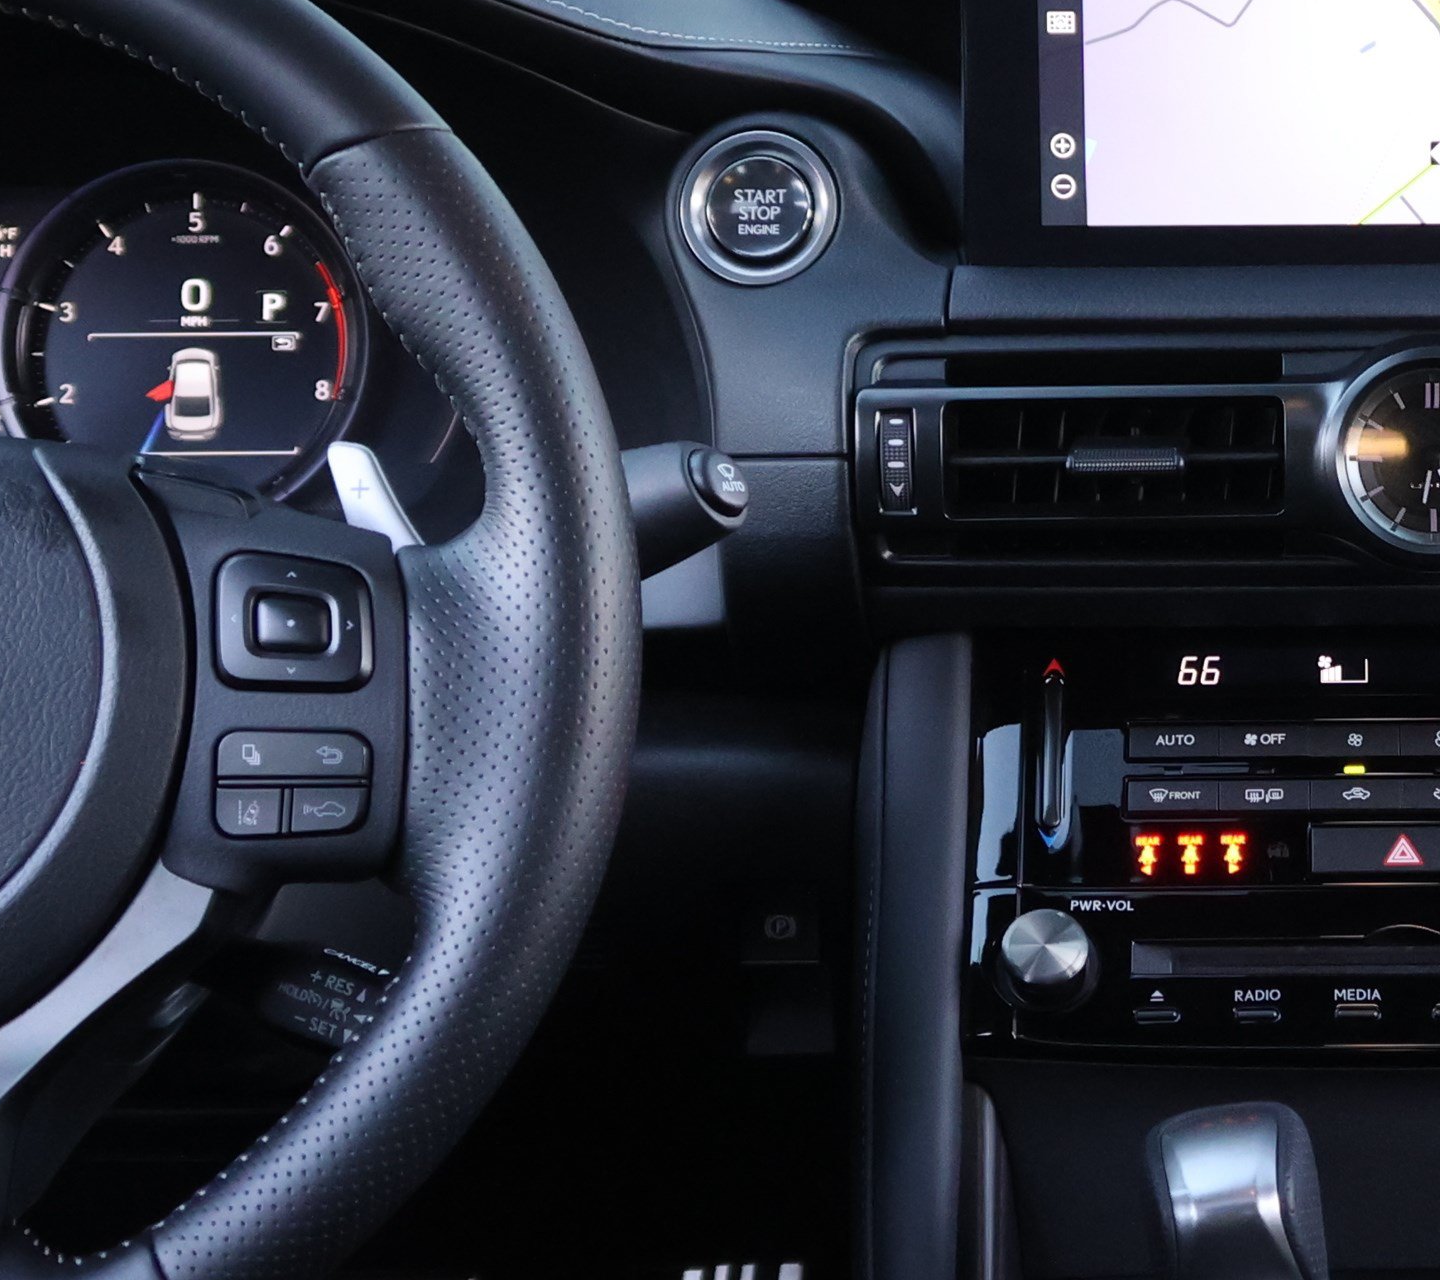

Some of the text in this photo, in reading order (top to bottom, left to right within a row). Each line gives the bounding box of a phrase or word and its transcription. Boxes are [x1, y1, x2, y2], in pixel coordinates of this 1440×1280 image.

[734, 189, 787, 204] START
[738, 206, 782, 220] STOP
[188, 212, 205, 233] 5
[738, 224, 780, 235] ENGINE
[0, 243, 14, 258] H
[107, 236, 125, 256] 4
[263, 235, 281, 256] 6
[180, 278, 209, 312] 0
[59, 302, 75, 322] 3
[262, 292, 284, 321] P
[313, 301, 331, 322] 7
[180, 316, 209, 327] MPH
[59, 383, 75, 404] 2
[314, 379, 331, 401] 8
[721, 480, 746, 492] AUTO
[1177, 656, 1220, 685] 66
[1155, 734, 1195, 746] AUTO
[1260, 733, 1286, 745] OFF
[1168, 790, 1201, 800] FRONT
[1135, 835, 1161, 846] REAR
[1177, 834, 1203, 846] REAR
[1220, 834, 1246, 845] REAR
[323, 948, 377, 973] CANCEL
[324, 974, 356, 997] RES
[1234, 989, 1281, 1002] RADIO
[1334, 988, 1382, 1001] MEDIA
[309, 1017, 338, 1039] SET
